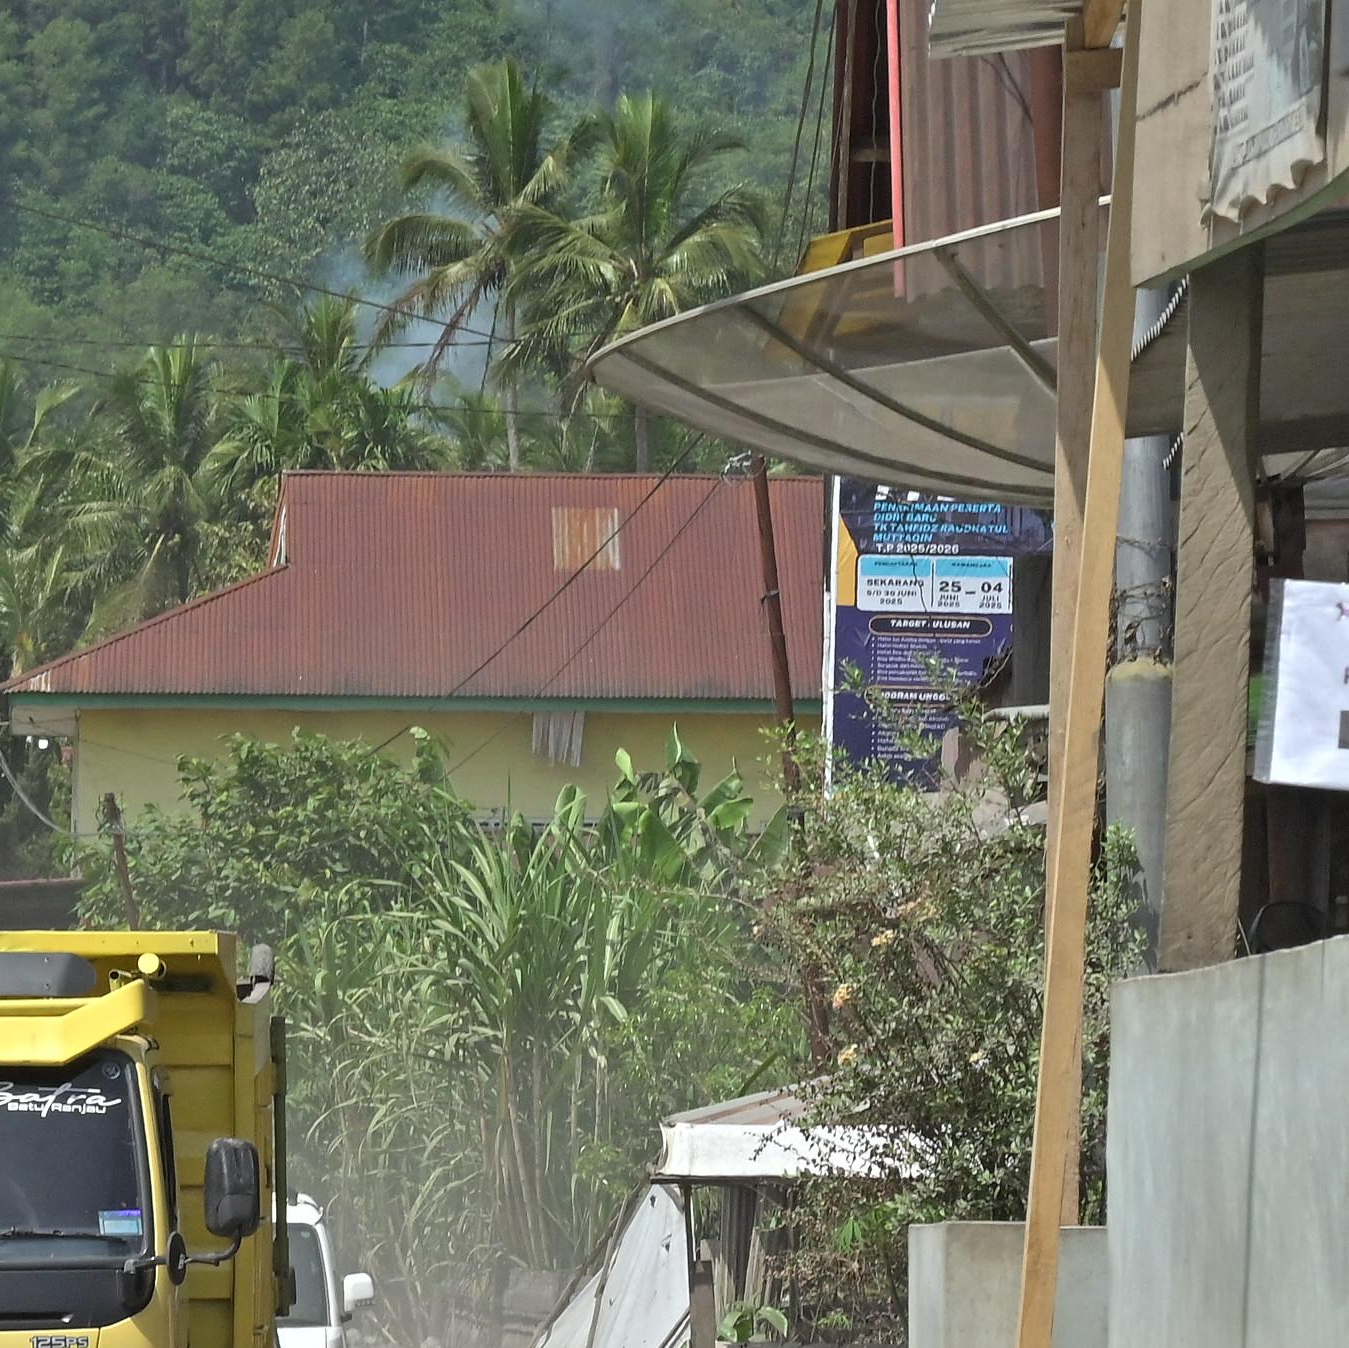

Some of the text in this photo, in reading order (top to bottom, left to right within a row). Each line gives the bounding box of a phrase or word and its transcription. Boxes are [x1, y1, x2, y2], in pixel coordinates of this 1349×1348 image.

[939, 581, 1003, 593] 25 04
[927, 620, 970, 629] ULUSAN
[881, 691, 918, 701] OGRAM
